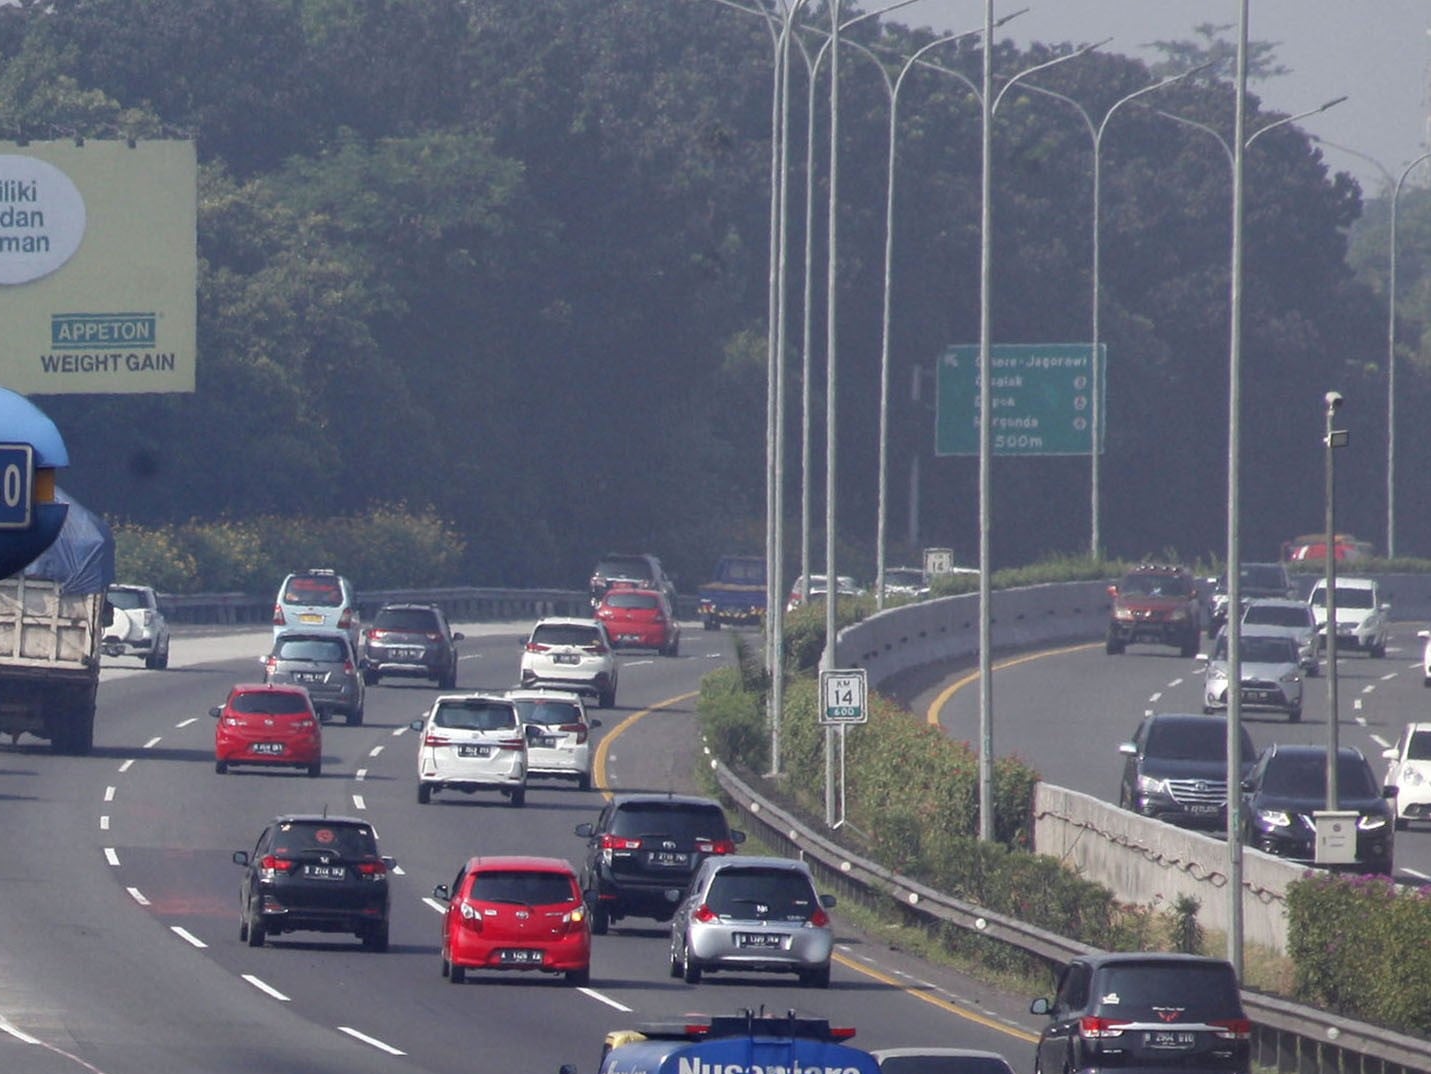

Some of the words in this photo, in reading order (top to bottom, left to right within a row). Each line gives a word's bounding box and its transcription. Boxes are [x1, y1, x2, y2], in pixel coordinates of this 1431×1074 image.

[58, 321, 150, 341] APPETON
[41, 353, 122, 373] WEIGHT
[126, 353, 176, 371] GAIN
[834, 690, 853, 705] 14
